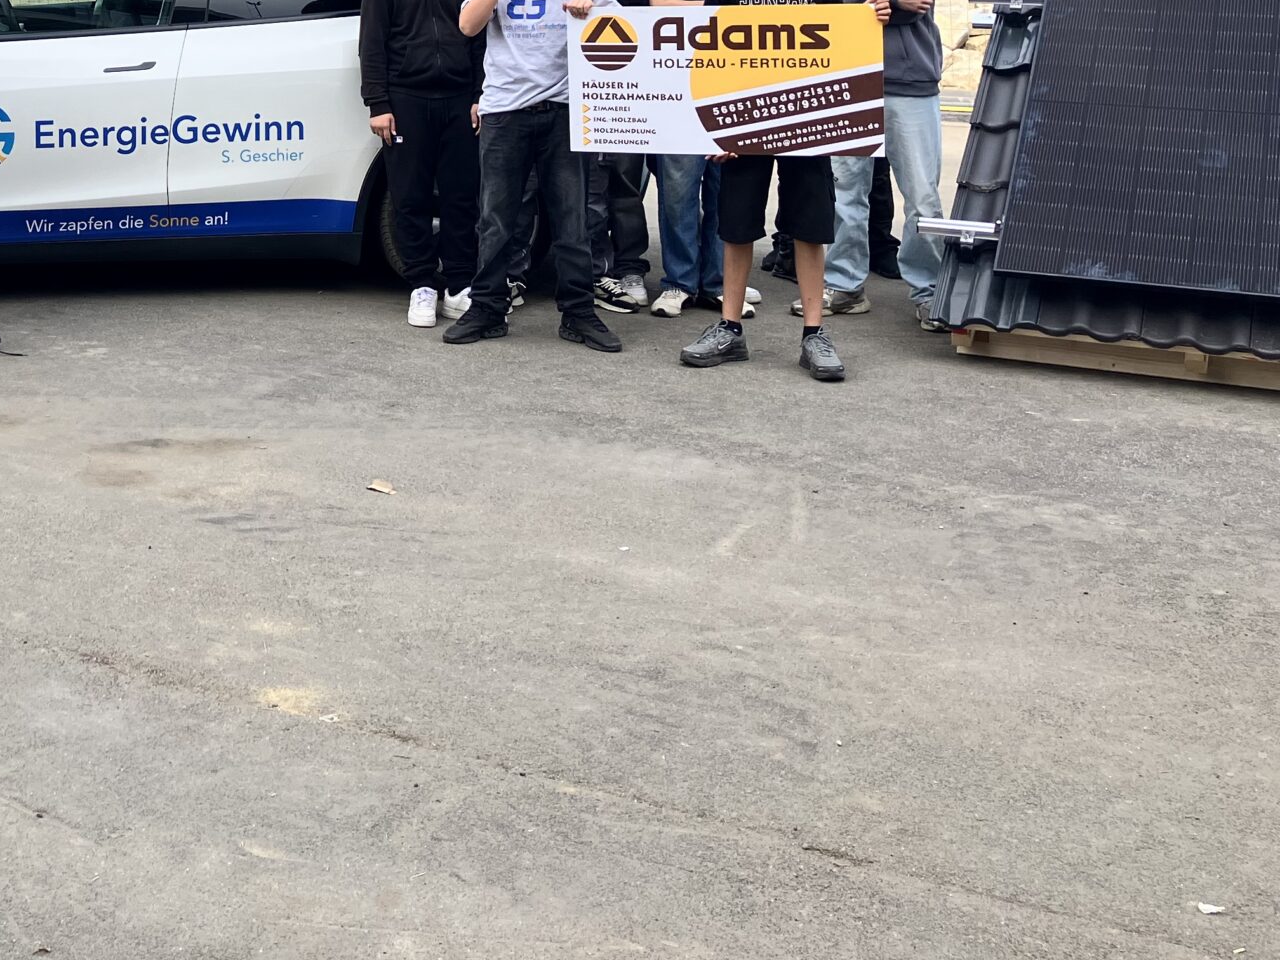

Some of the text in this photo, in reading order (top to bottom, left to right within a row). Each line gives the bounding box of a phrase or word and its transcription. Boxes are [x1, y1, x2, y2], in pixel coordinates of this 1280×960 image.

[652, 16, 830, 51] Adams
[653, 58, 726, 69] HOLZBAU
[740, 57, 831, 69] FERTIGBAU
[582, 79, 624, 89] HÄUSER
[582, 92, 683, 101] HOLZRAHMENBAU
[712, 82, 849, 116] 56651 Niederzissen
[716, 91, 851, 126] Tel.: 02636/9311-0
[34, 114, 305, 155] EnergieGewinn
[593, 127, 657, 135] HOLZHANDLUNG
[737, 119, 850, 146] www.adams-holzbau.de
[763, 122, 880, 150] info@adams-holzbau.de
[221, 148, 304, 163] S. Geschier
[26, 212, 229, 234] Wir zapfen die Sonne an!
